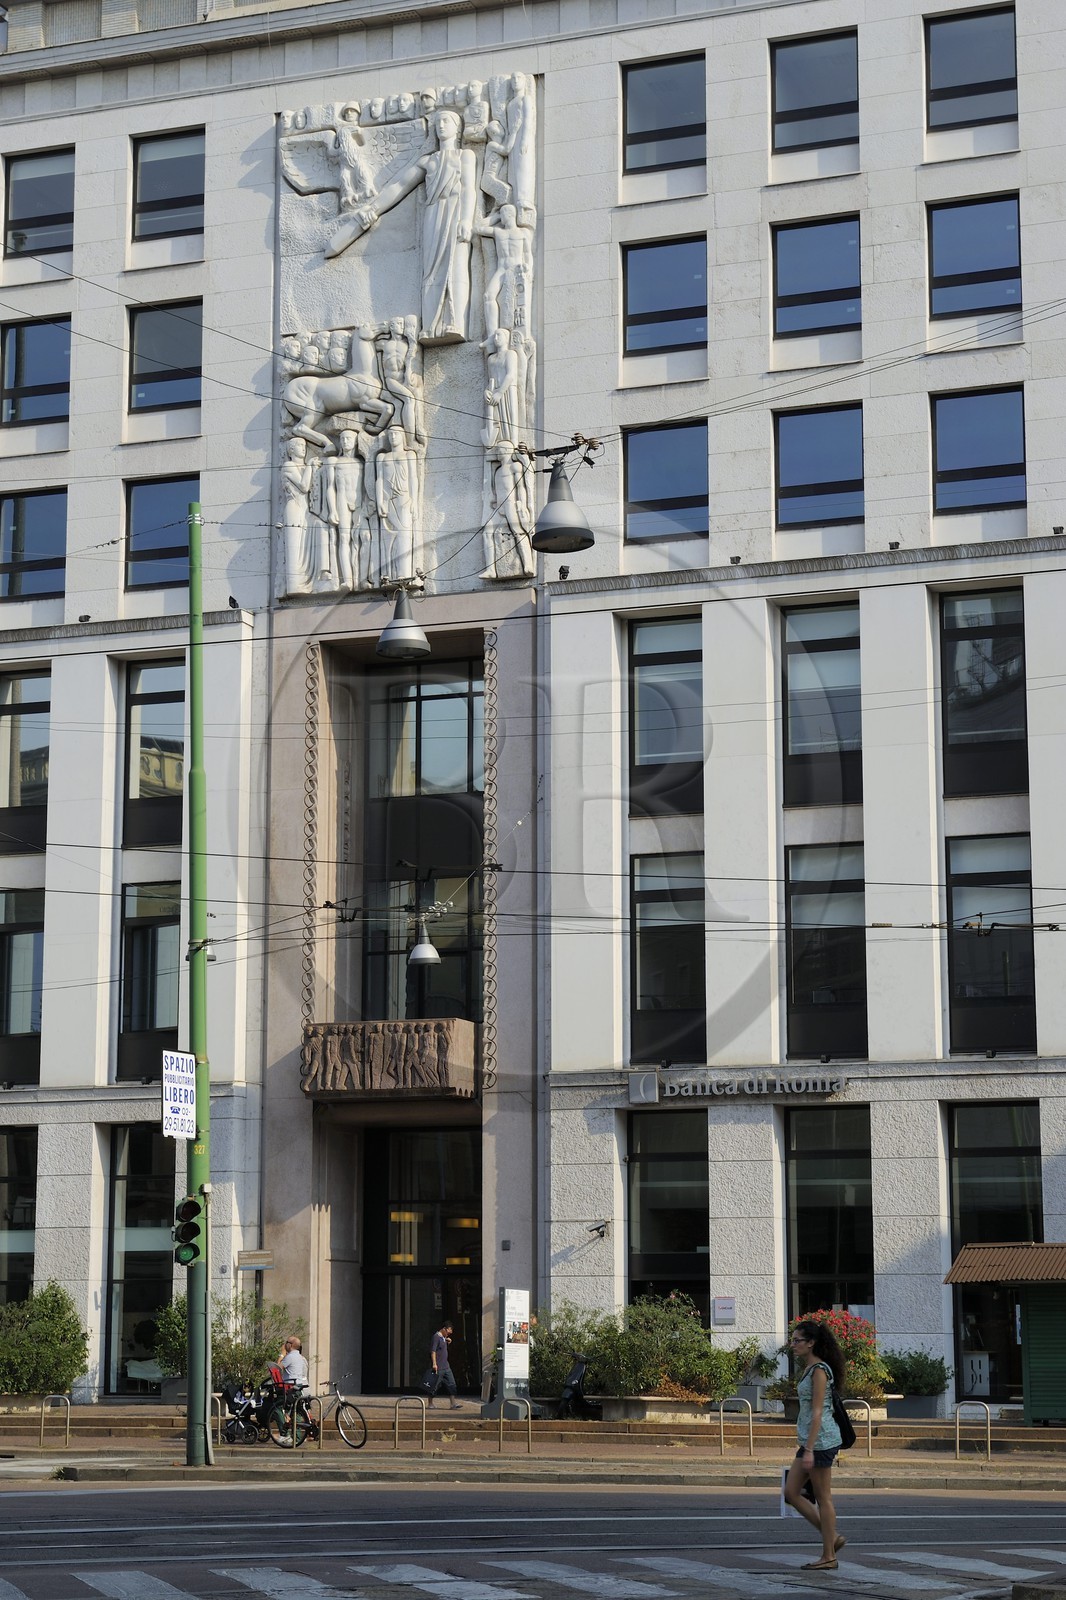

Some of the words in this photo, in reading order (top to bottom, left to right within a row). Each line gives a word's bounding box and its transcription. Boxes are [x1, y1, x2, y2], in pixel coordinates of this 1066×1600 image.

[164, 1055, 194, 1074] SPAZIO
[164, 1073, 194, 1087] PUBBLICITARIO
[663, 1077, 739, 1097] Banca
[743, 1076, 769, 1095] di
[774, 1074, 847, 1094] Roma
[164, 1086, 195, 1105] LIBERO
[194, 1145, 206, 1155] 327
